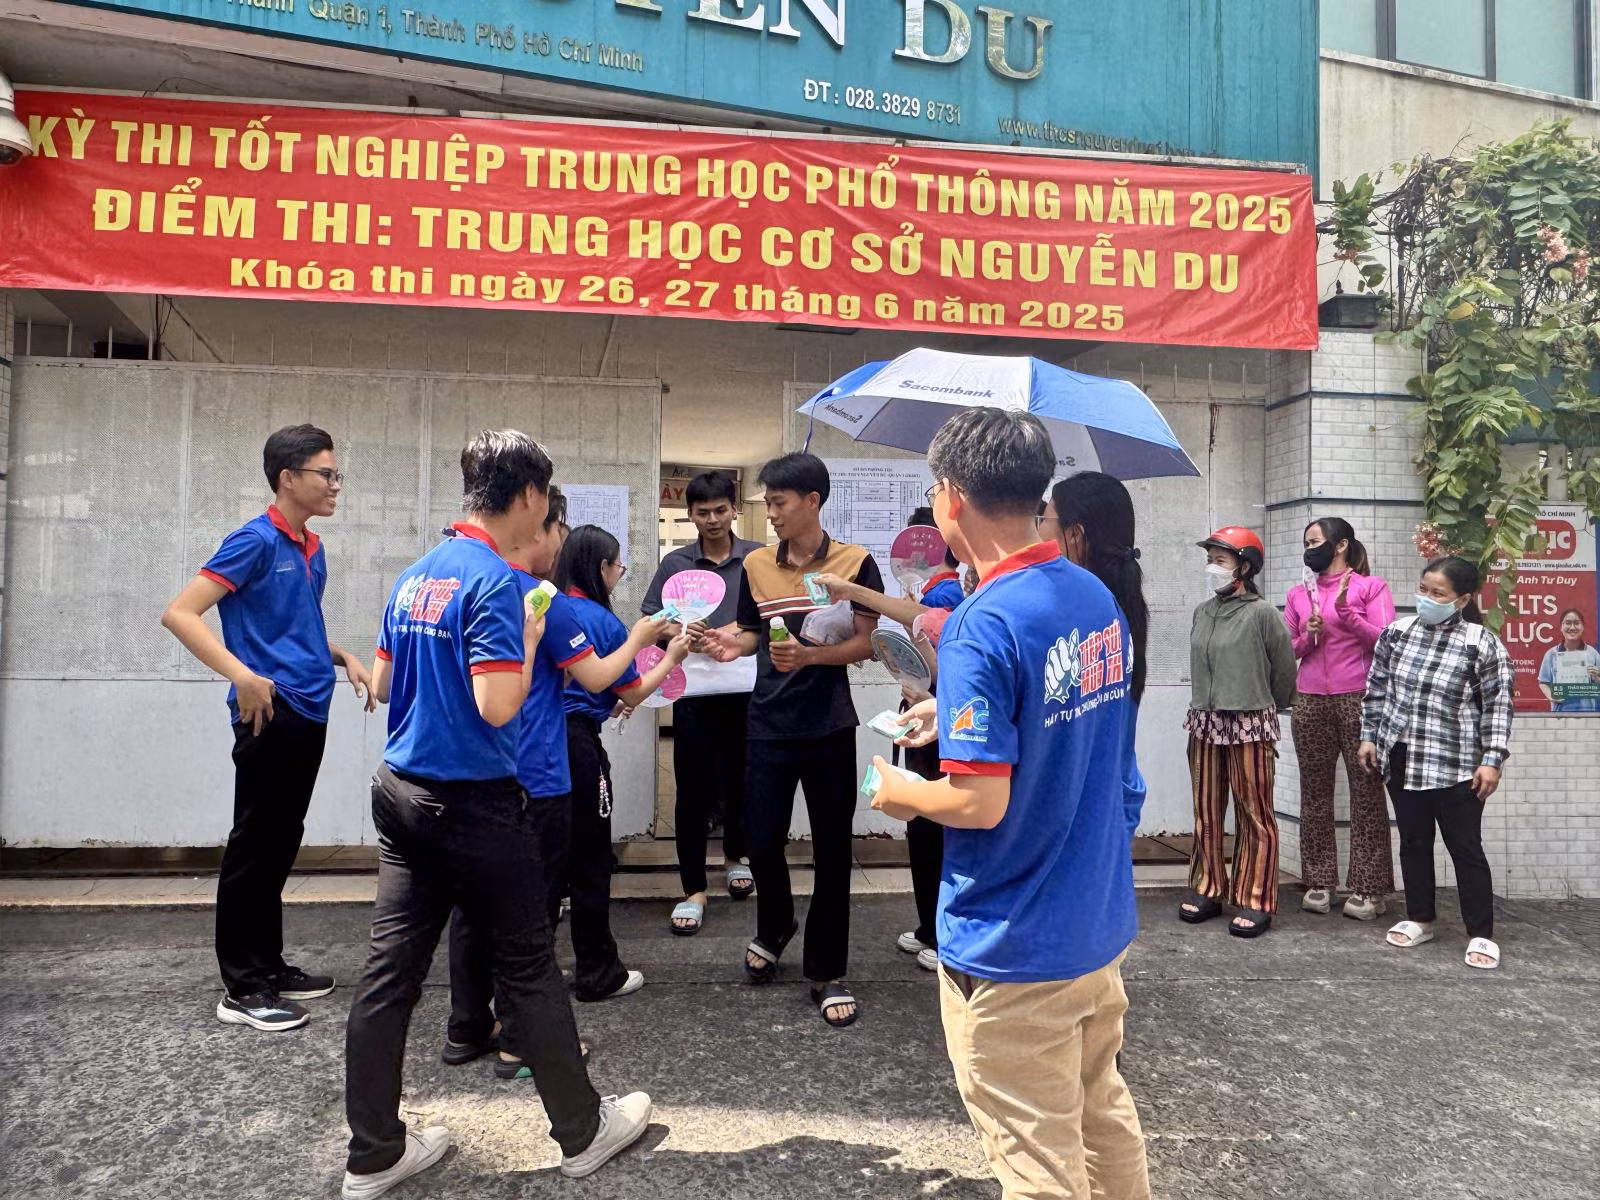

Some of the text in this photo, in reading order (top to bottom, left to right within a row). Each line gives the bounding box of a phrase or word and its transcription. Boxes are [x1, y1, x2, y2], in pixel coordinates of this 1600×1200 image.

[309, 0, 369, 28] Quận
[378, 5, 392, 33] 1,
[402, 9, 466, 43] Thành
[475, 22, 516, 50] Phố
[524, 31, 550, 56] Hồ
[559, 36, 592, 63] Chí
[599, 42, 644, 72] Minh
[892, 0, 1054, 80] DU
[845, 86, 921, 118] 028.3829
[927, 100, 961, 125] 8731
[29, 109, 1292, 234] KỲ THI TỐT NGHIỆP TRUNG HỌC PHỔ THÔNG NĂM 2025
[93, 177, 1238, 293] ĐIỂM THI: TRUNG HỌC CƠ SỞ NGUYỄN DU
[231, 258, 1124, 331] Khóa thi ngày 26, 27 tháng 6 năm 2025
[898, 380, 995, 399] Sacombank
[1517, 576, 1538, 584] Anh
[1541, 576, 1555, 585] Tư
[1556, 576, 1577, 586] Duy
[1506, 621, 1553, 647] LỰC
